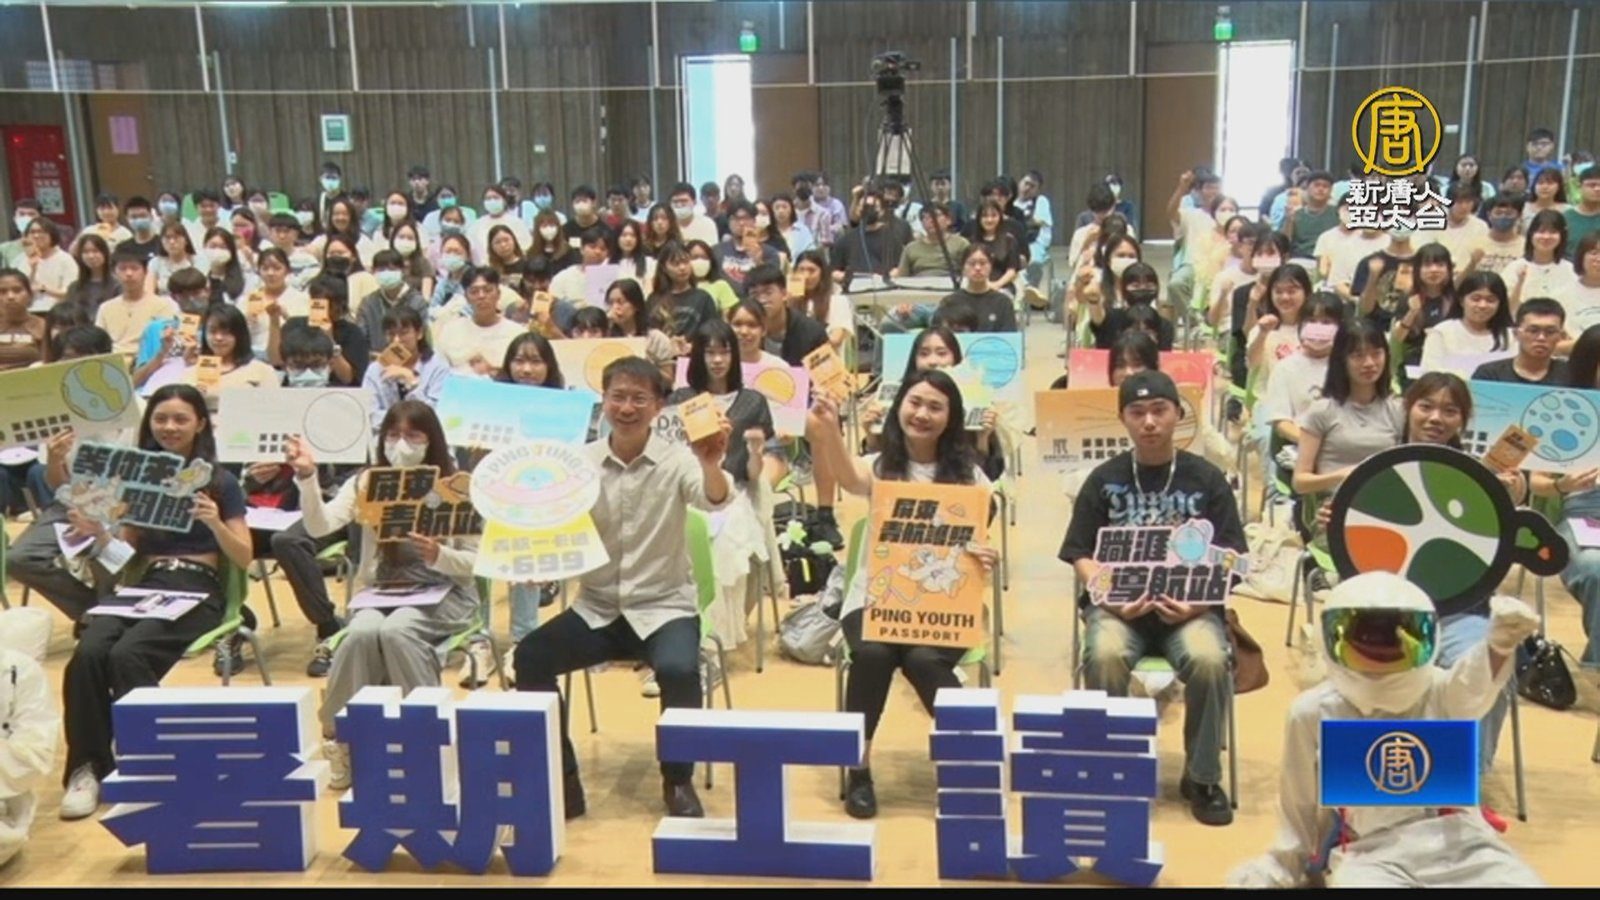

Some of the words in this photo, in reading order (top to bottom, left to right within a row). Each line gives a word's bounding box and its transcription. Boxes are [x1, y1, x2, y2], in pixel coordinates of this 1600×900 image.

[366, 469, 436, 502] 屏東
[892, 498, 939, 520] 屏東
[879, 520, 975, 548] 青航護照
[1098, 529, 1174, 563] 職涯
[1108, 564, 1230, 602] 導航站
[870, 608, 912, 623] PING
[917, 612, 975, 628] YOUTH
[880, 627, 961, 642] PASSPORT
